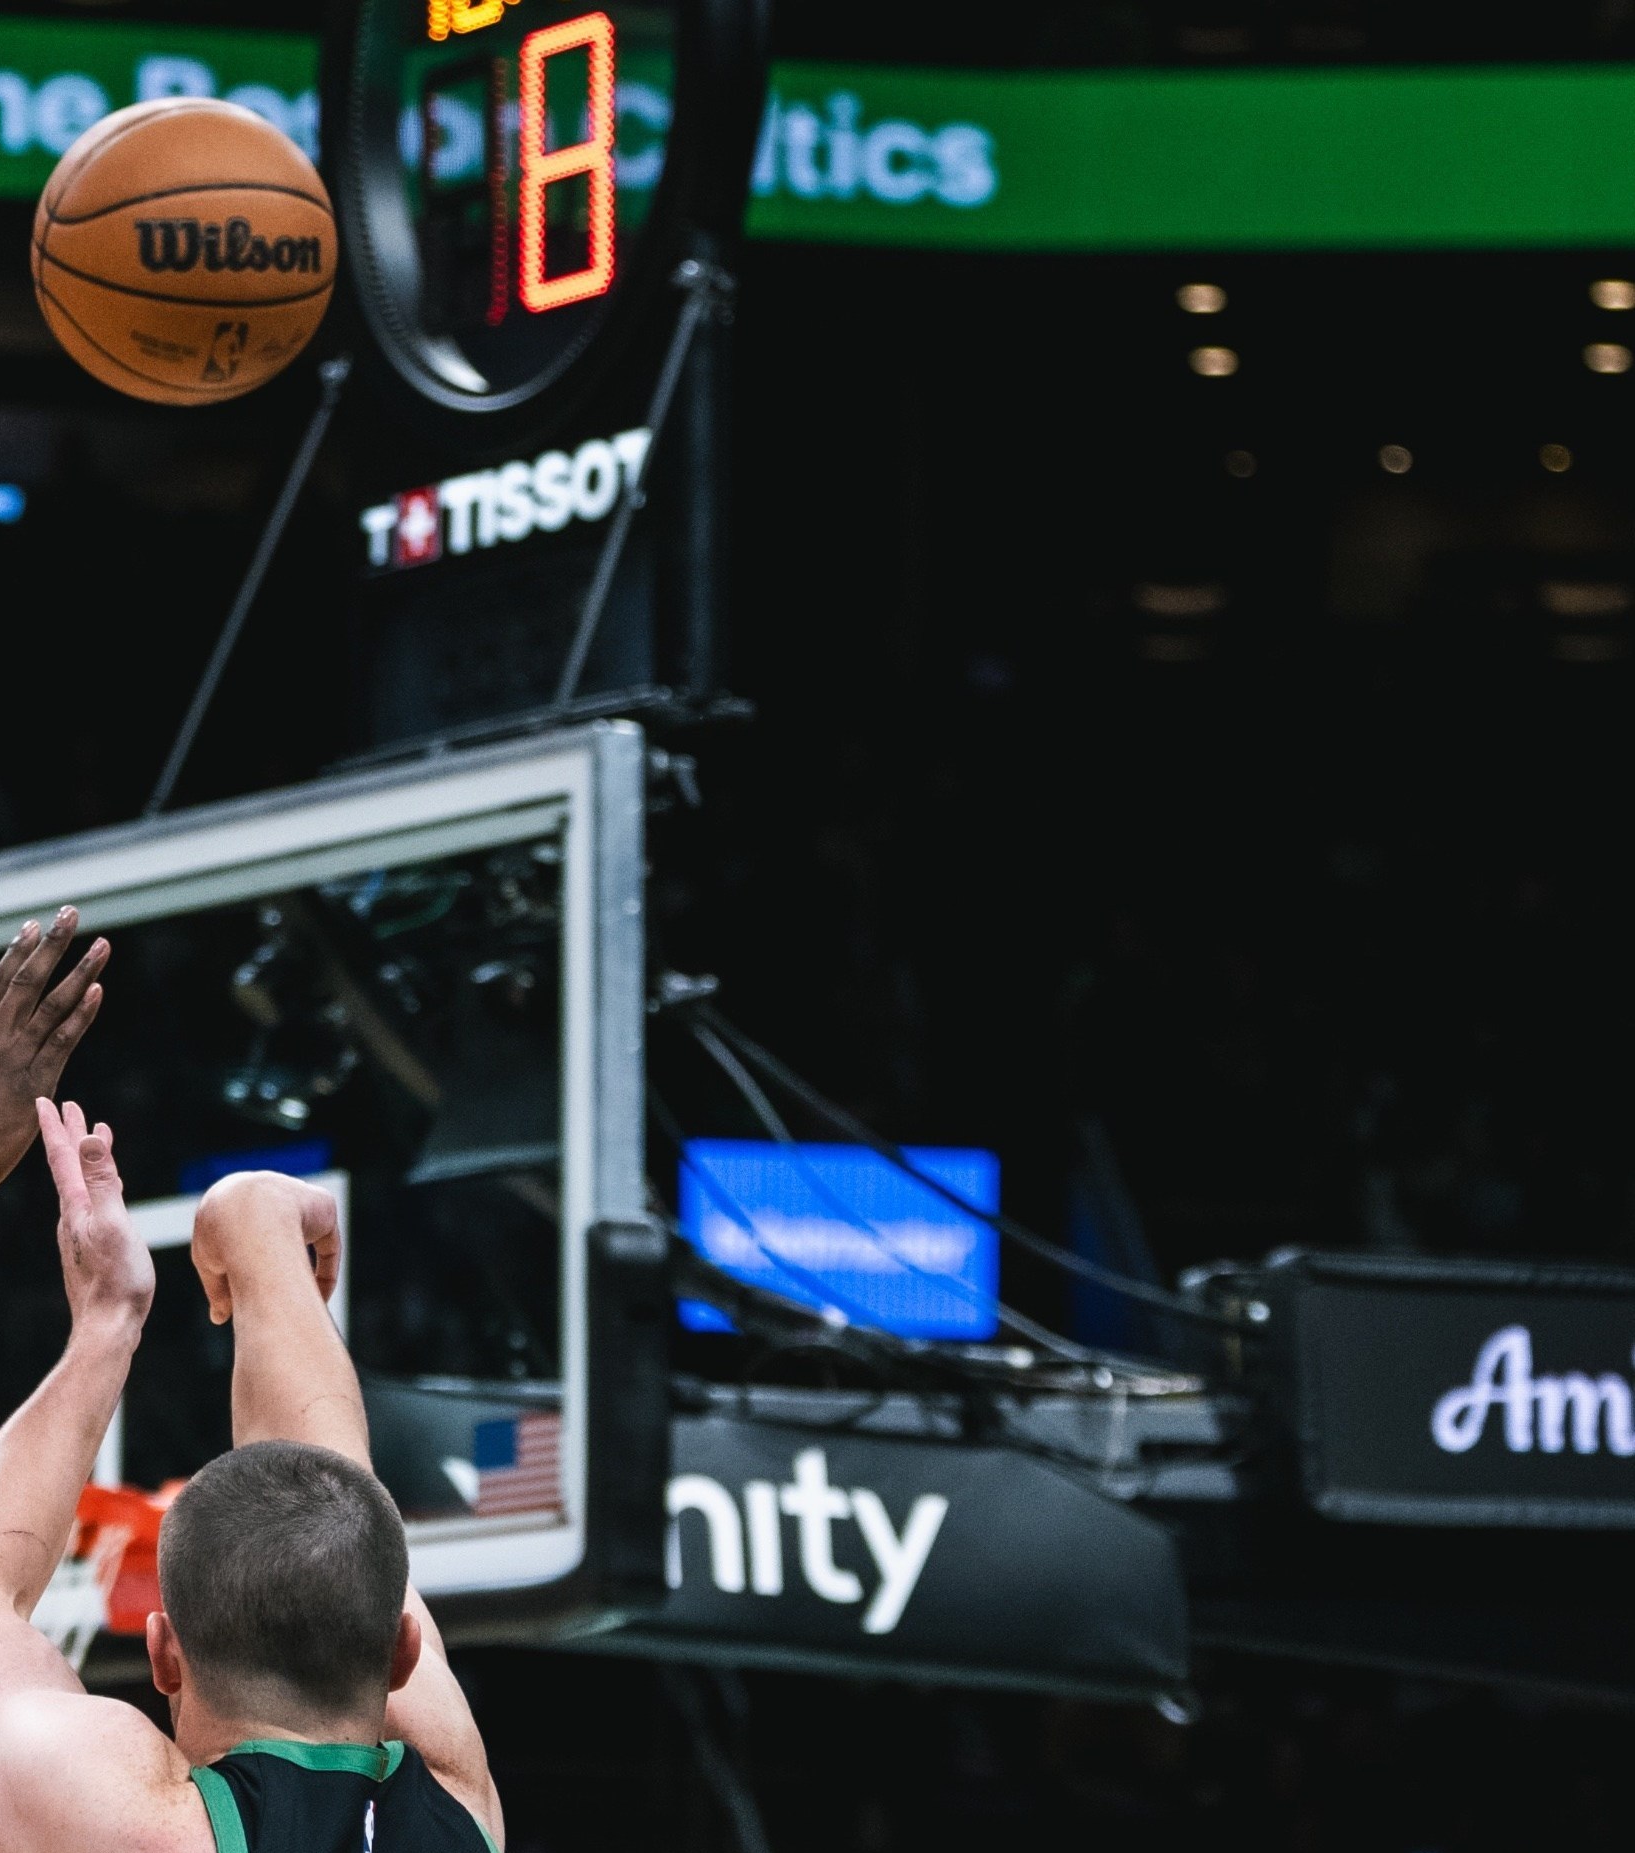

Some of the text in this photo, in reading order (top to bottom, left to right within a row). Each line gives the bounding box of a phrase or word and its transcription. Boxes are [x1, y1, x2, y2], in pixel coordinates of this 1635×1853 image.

[519, 12, 615, 313] 8
[134, 216, 322, 275] Wilson
[438, 427, 653, 554] TISSOT
[1431, 1324, 1635, 1456] Am
